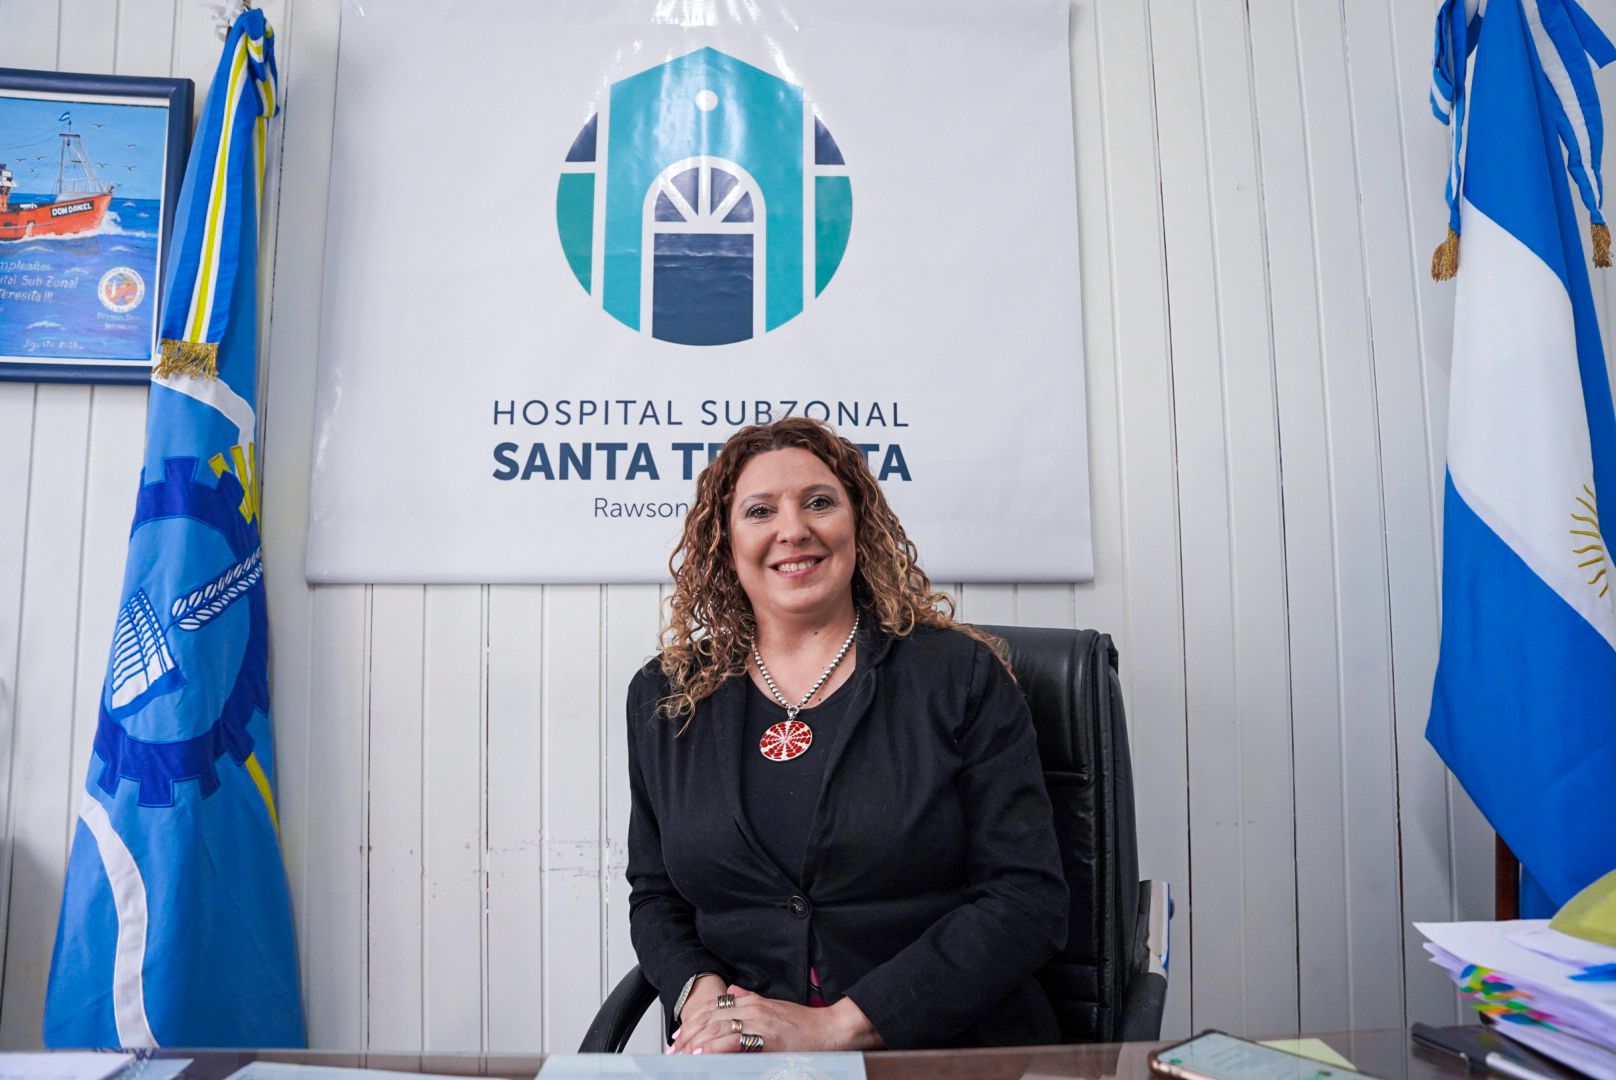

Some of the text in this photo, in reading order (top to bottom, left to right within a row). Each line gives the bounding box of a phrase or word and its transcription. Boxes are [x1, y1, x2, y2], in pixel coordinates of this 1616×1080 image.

[68, 202, 93, 213] DANIEL
[21, 274, 43, 286] Sub
[46, 275, 79, 289] Zonal
[493, 399, 909, 427] HOSPITAL SUBZONAL
[492, 441, 660, 481] SANTA
[594, 497, 689, 518] Rawson
